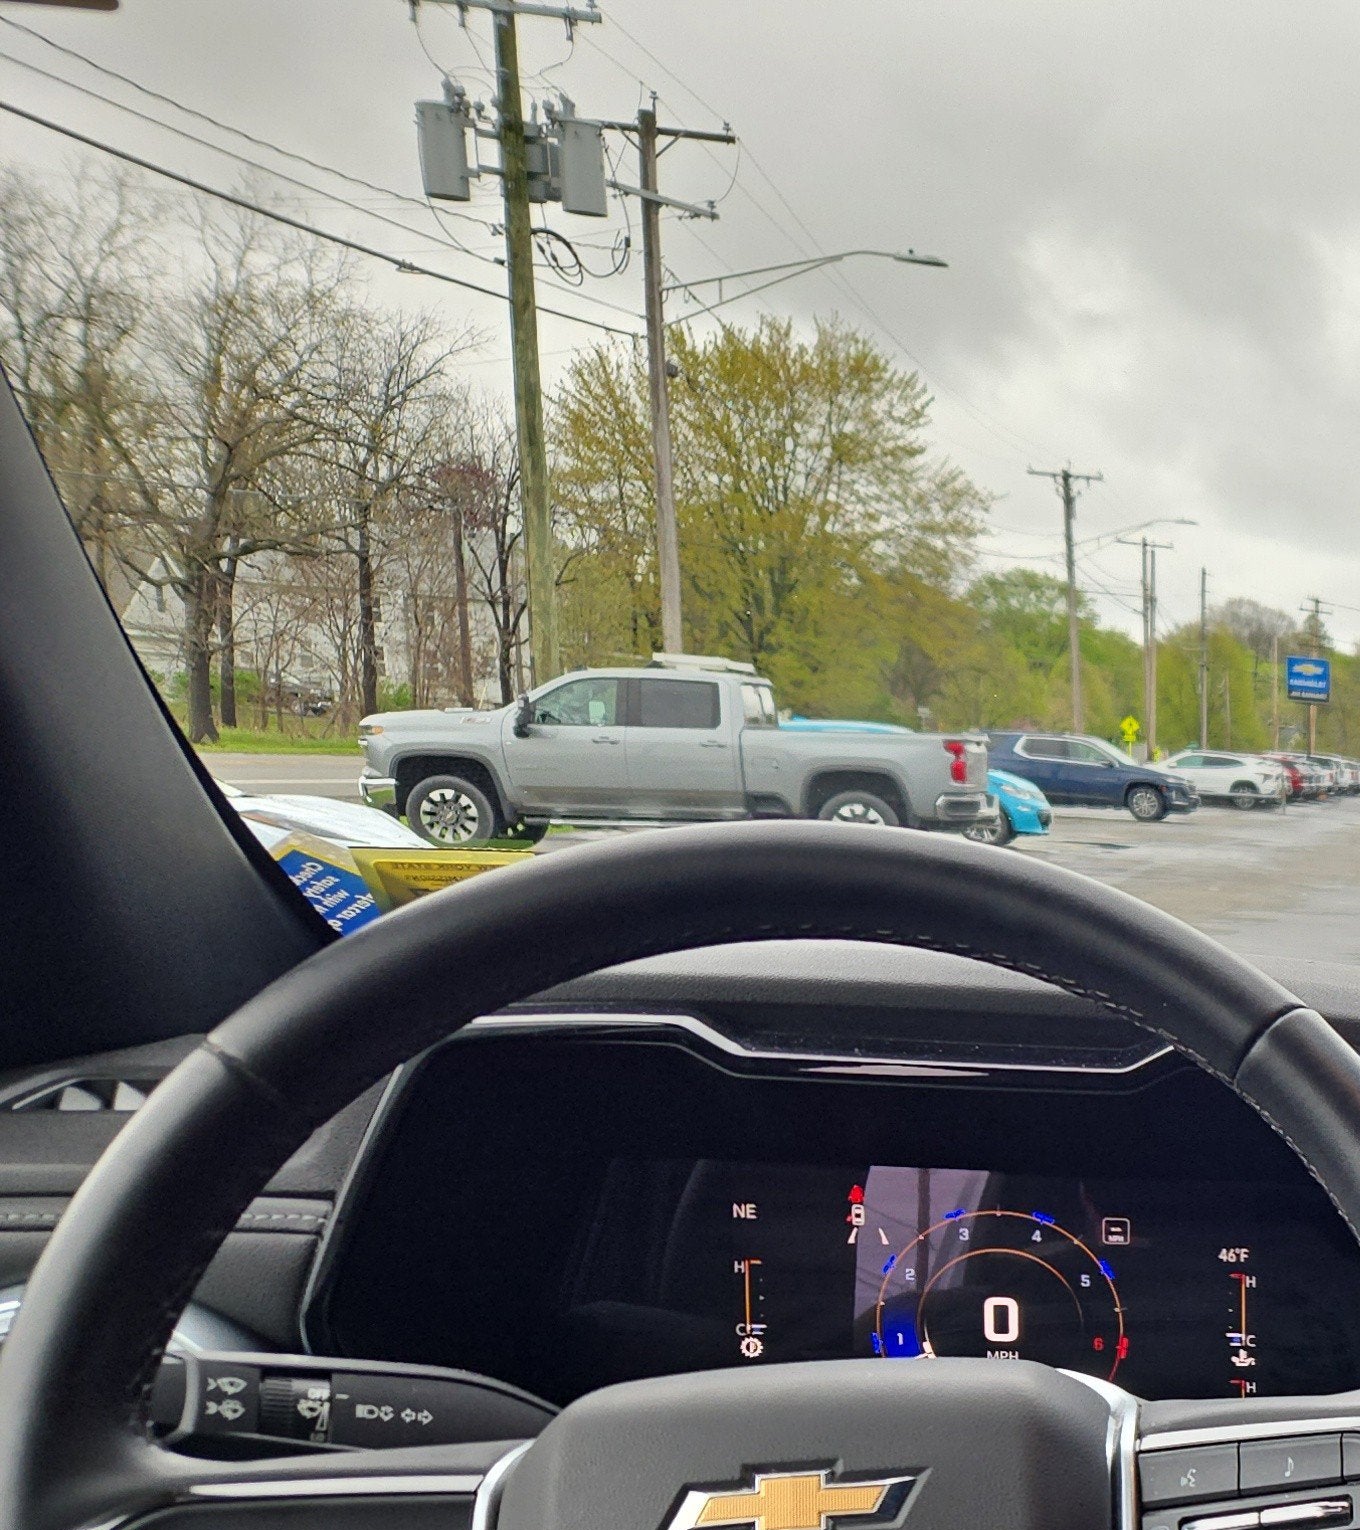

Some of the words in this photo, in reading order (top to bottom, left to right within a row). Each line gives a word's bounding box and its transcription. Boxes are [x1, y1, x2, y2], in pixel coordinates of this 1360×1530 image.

[732, 1203, 757, 1219] NE
[958, 1227, 970, 1241] 3
[1031, 1229, 1042, 1242] 4
[905, 1268, 916, 1281] 2
[1080, 1274, 1092, 1288] 5
[1245, 1275, 1257, 1288] H
[983, 1296, 1019, 1342] 0
[896, 1332, 904, 1346] 1
[1093, 1337, 1105, 1350] 6
